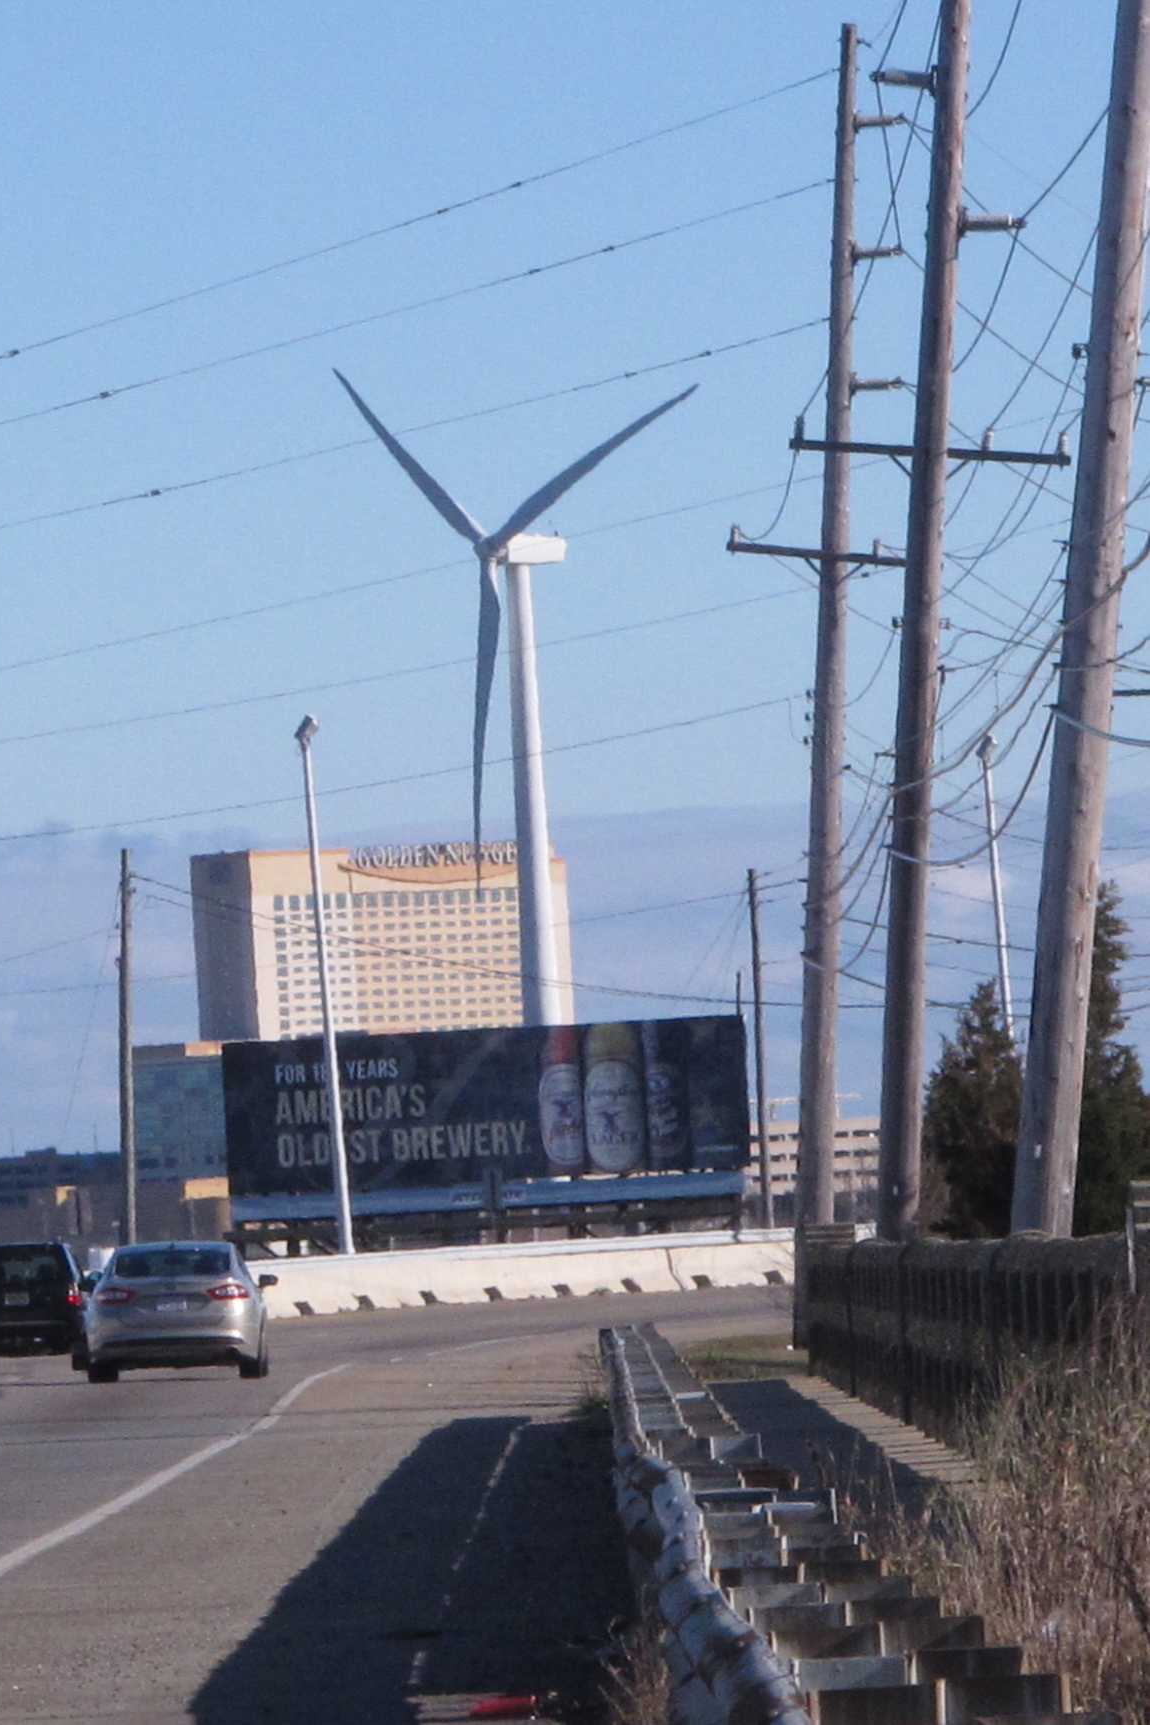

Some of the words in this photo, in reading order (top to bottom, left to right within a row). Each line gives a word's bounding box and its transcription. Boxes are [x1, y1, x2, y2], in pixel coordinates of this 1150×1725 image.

[358, 844, 439, 868] GOLDEN
[445, 840, 518, 867] NUGE
[274, 1063, 306, 1085] FOR
[345, 1057, 399, 1080] YEARS
[275, 1083, 427, 1125] AMERICA'S
[277, 1129, 381, 1168] OLDST
